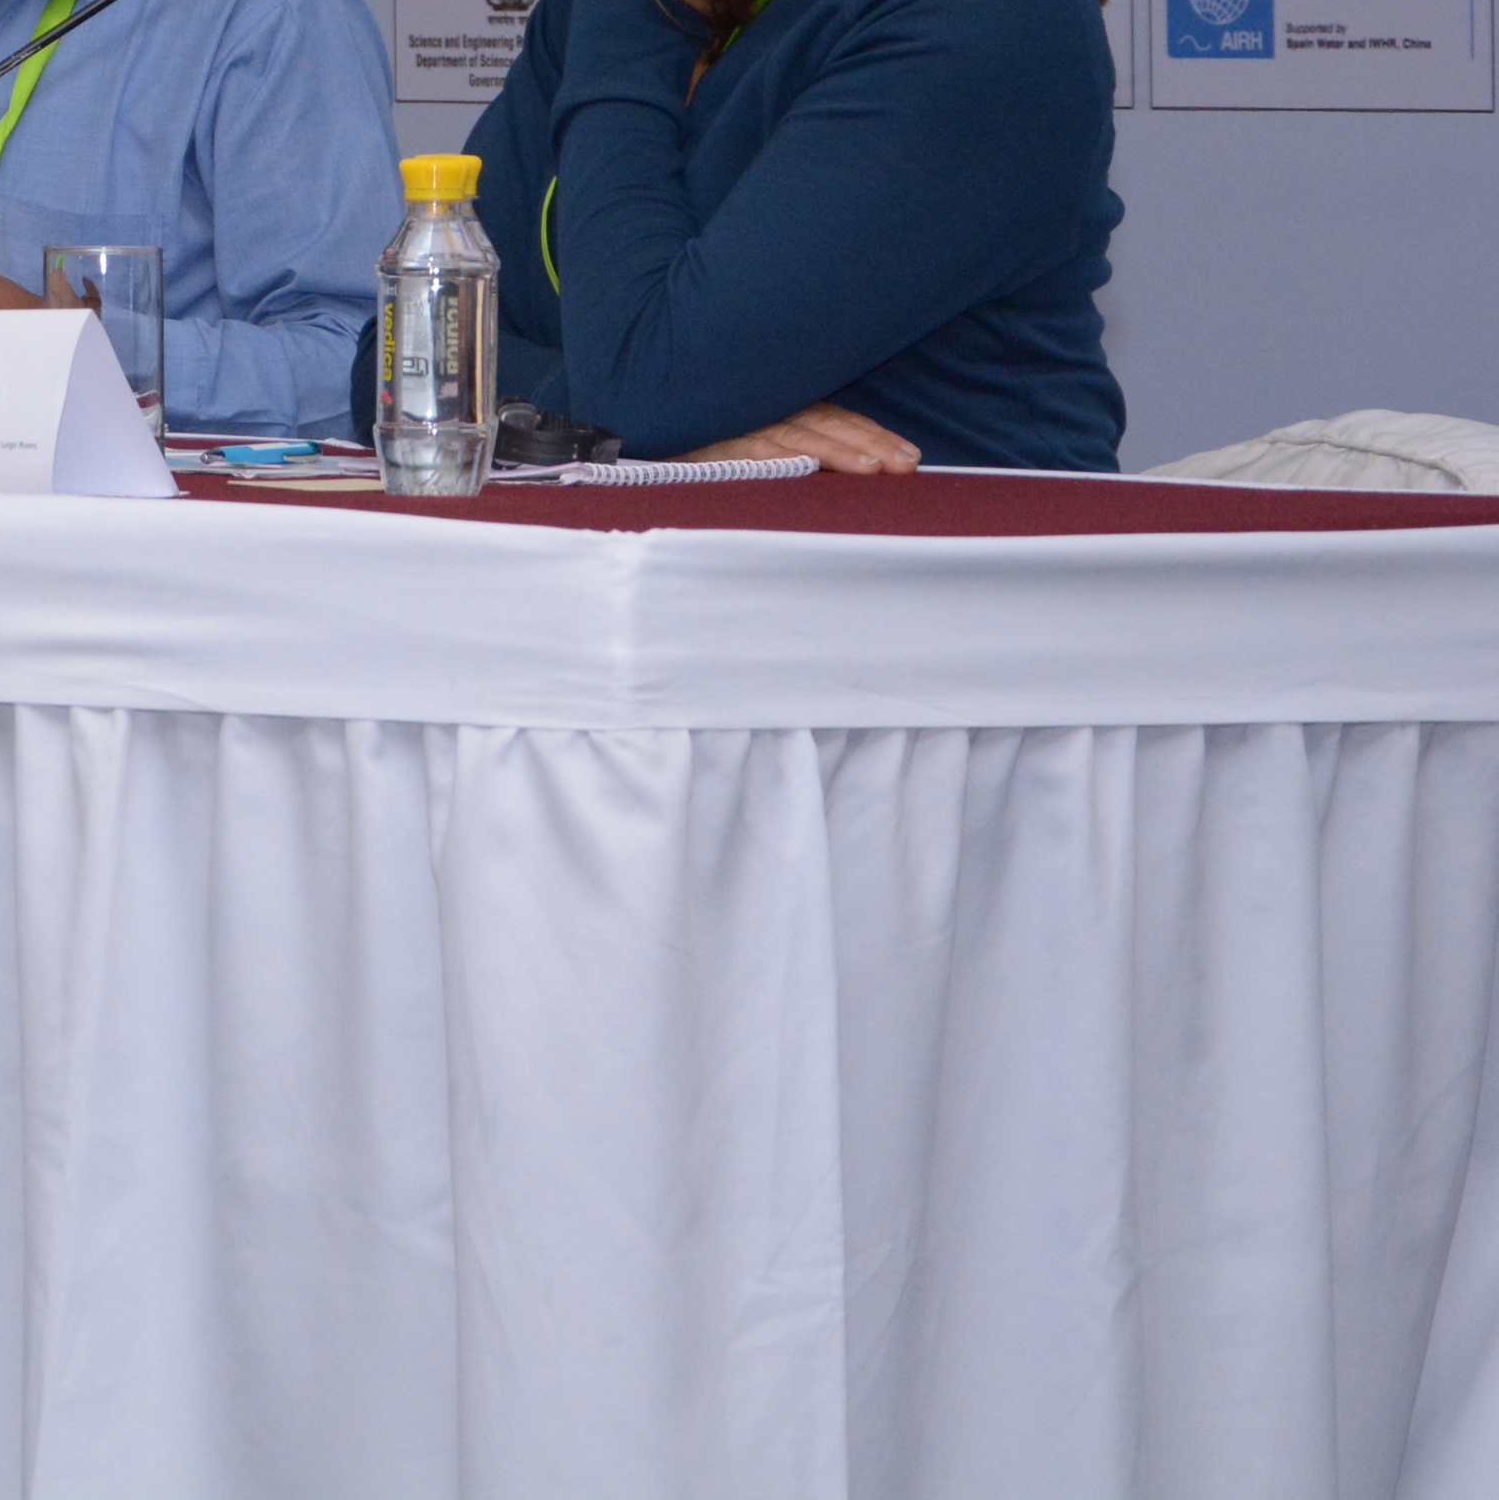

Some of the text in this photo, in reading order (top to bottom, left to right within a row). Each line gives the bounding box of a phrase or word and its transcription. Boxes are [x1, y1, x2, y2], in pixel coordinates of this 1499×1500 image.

[409, 34, 442, 48] Science
[445, 35, 460, 48] and
[463, 34, 514, 52] Engineering
[1221, 31, 1263, 51] AIRH
[416, 53, 467, 69] Department
[469, 55, 478, 67] of
[469, 74, 506, 87] Govern
[384, 302, 397, 382] vedica
